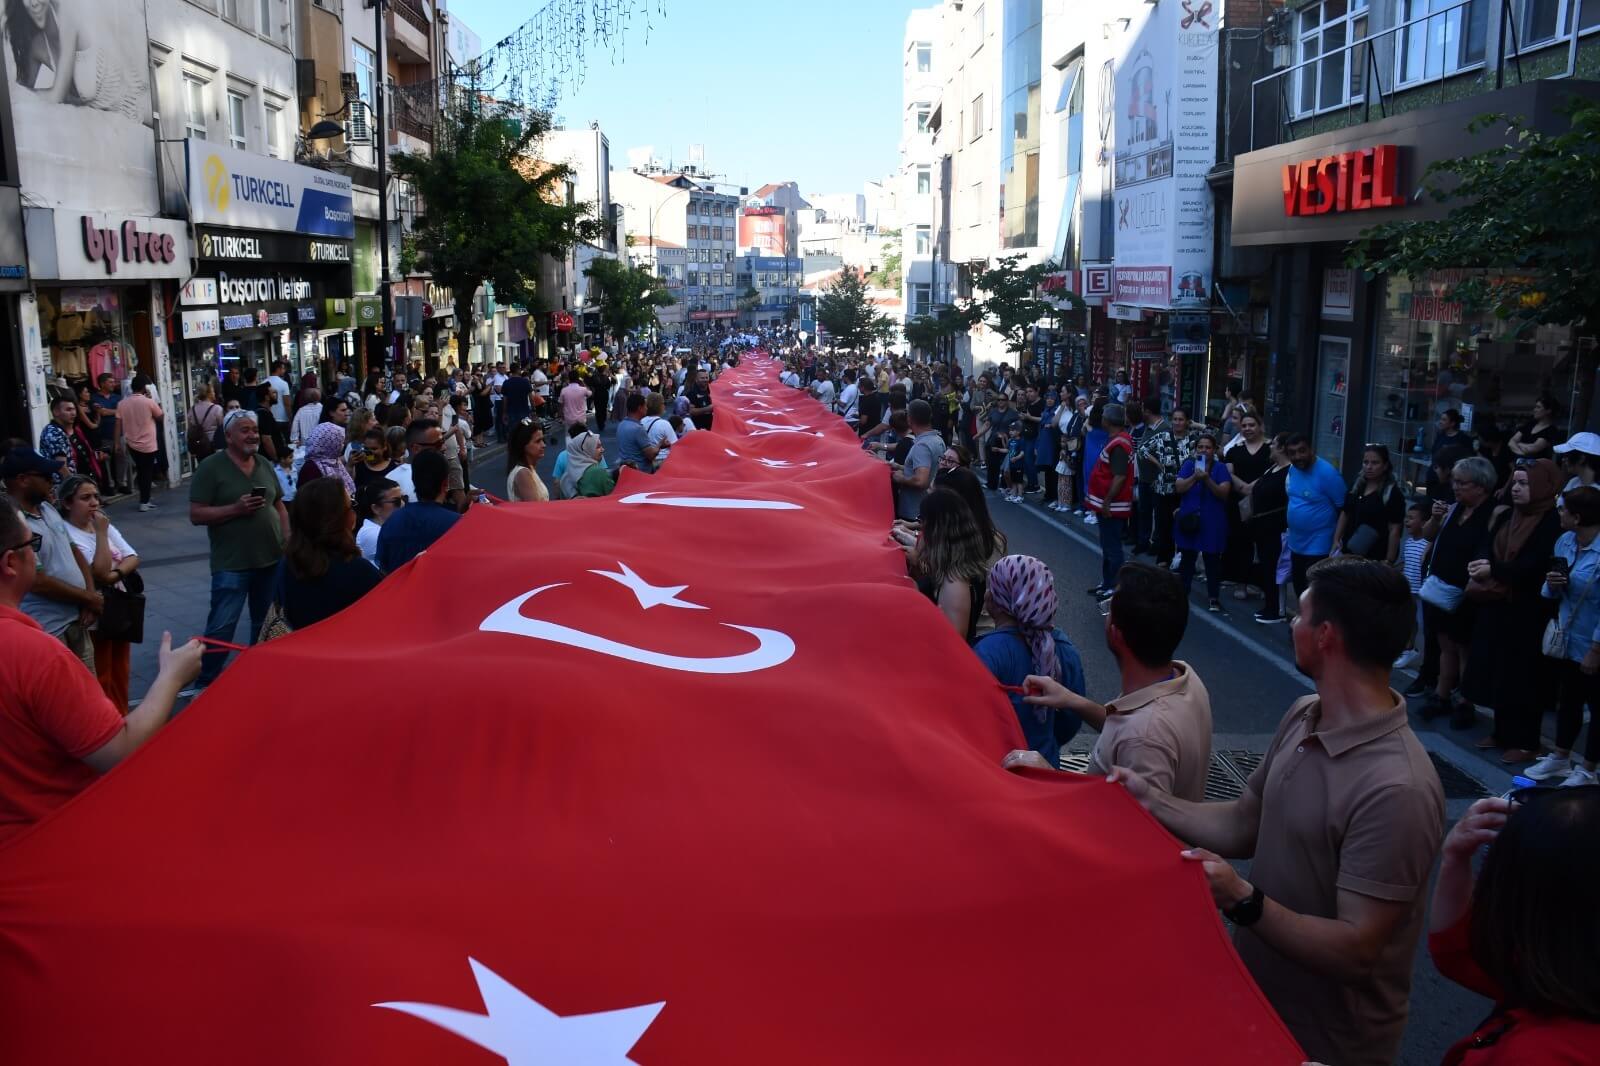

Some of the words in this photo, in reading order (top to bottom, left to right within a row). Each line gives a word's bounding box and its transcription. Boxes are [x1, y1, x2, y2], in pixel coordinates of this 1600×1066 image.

[232, 173, 295, 208] TURKCELL
[1281, 144, 1405, 217] VESTEL
[211, 236, 262, 259] TURKCELL
[316, 243, 350, 261] TURKCELL
[219, 271, 276, 306] Başaran
